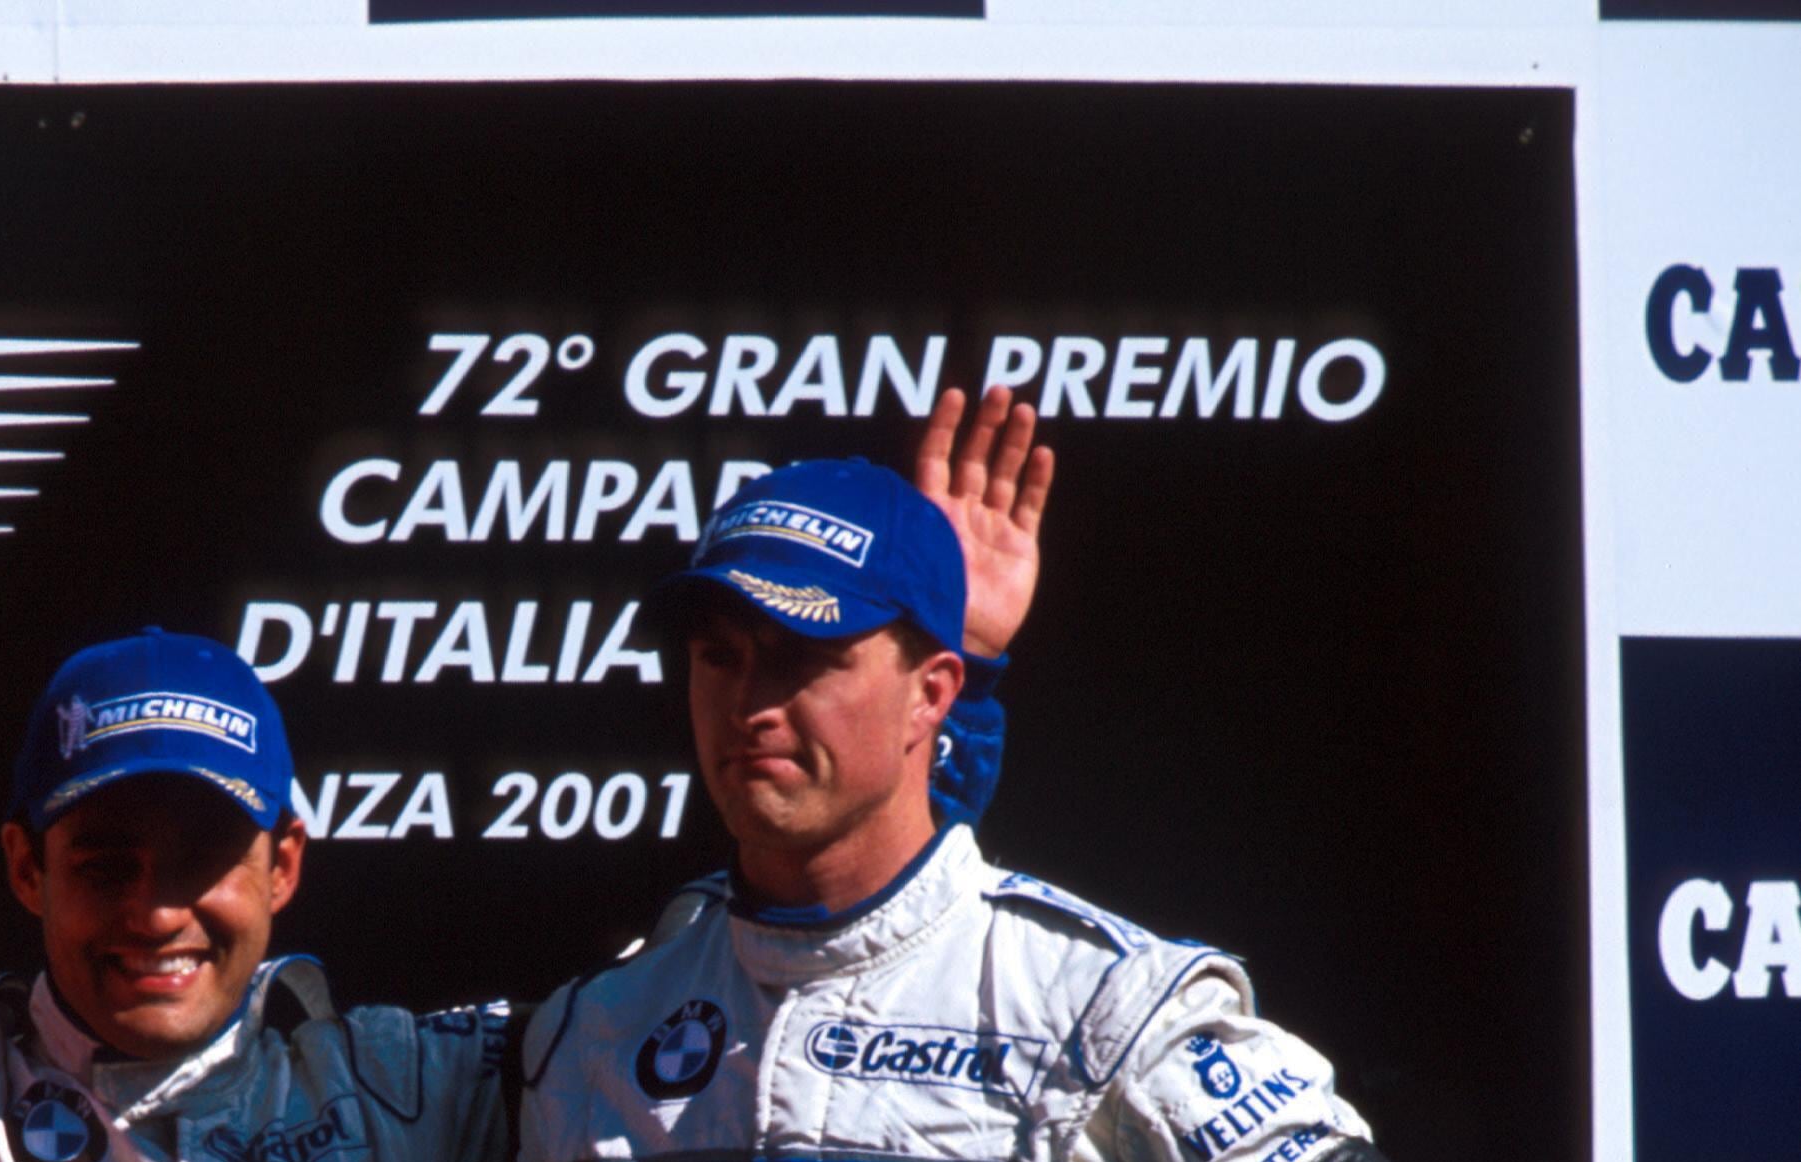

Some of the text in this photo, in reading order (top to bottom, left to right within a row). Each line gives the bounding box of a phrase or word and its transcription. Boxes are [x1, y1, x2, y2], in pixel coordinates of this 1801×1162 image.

[1645, 262, 1801, 383] CA
[624, 333, 946, 417] GRAN
[982, 335, 1386, 422] PREMIO
[319, 459, 805, 543] CAMPA
[718, 506, 865, 553] MICHELIN
[235, 601, 664, 683] D'ITALIA
[95, 698, 250, 738] MICHELIN
[481, 773, 690, 839] 2001
[1657, 877, 1801, 1001] CA
[862, 1028, 1011, 1084] Castrol
[1186, 1067, 1311, 1162] VELTINS
